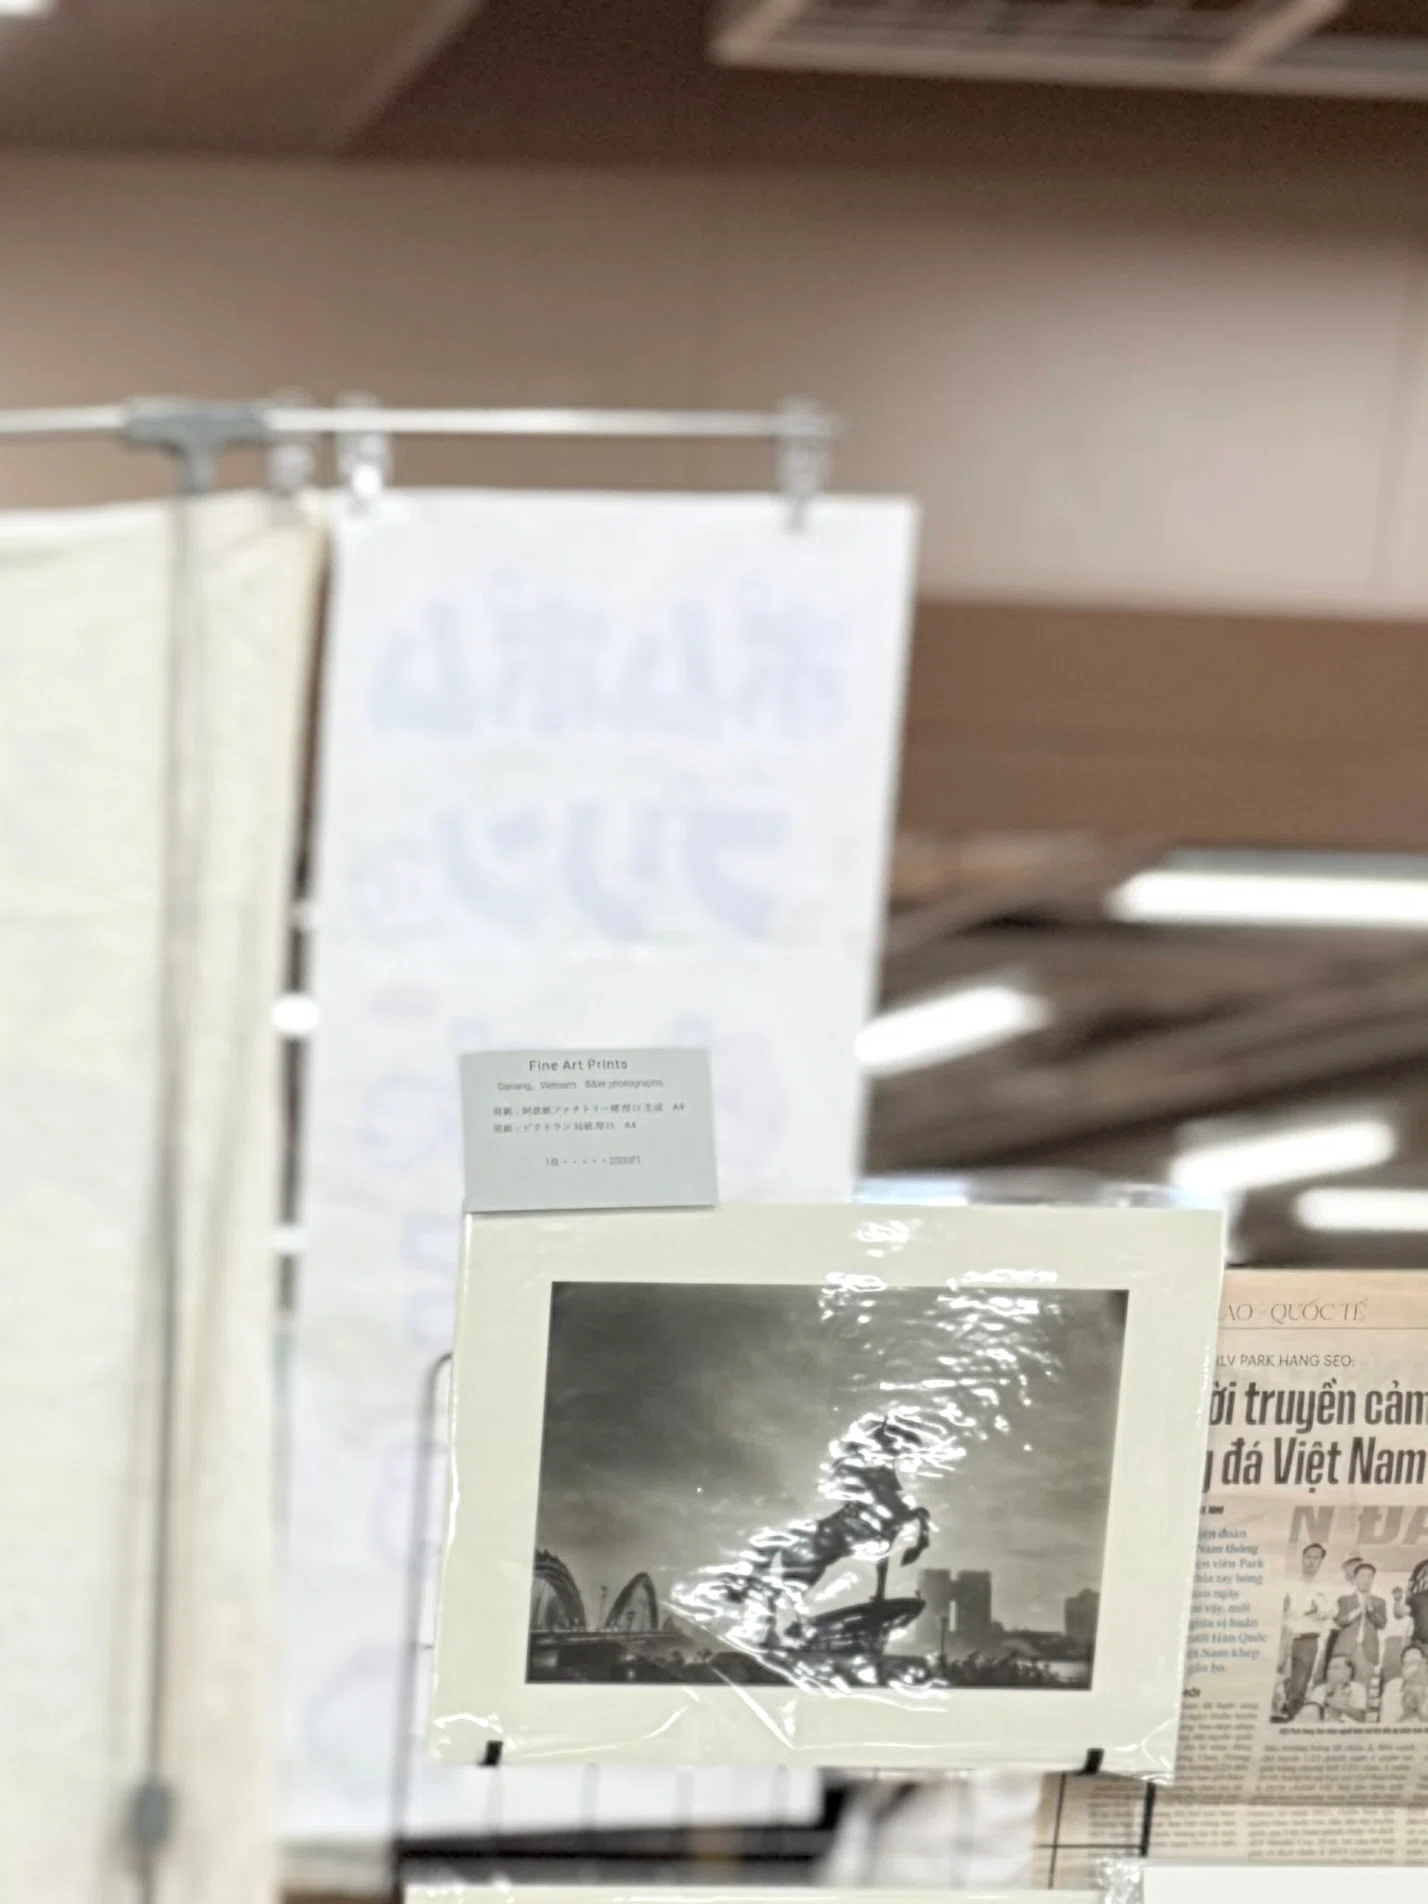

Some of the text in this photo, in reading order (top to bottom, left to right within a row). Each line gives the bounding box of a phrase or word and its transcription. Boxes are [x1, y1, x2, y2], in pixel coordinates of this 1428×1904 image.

[529, 1059, 628, 1071] Fine Art Prints
[1239, 1355, 1275, 1367] PARK
[1279, 1355, 1320, 1367] HANG
[1245, 1377, 1356, 1433] truyền
[1222, 1440, 1264, 1485] đá
[1273, 1436, 1339, 1493] Việt
